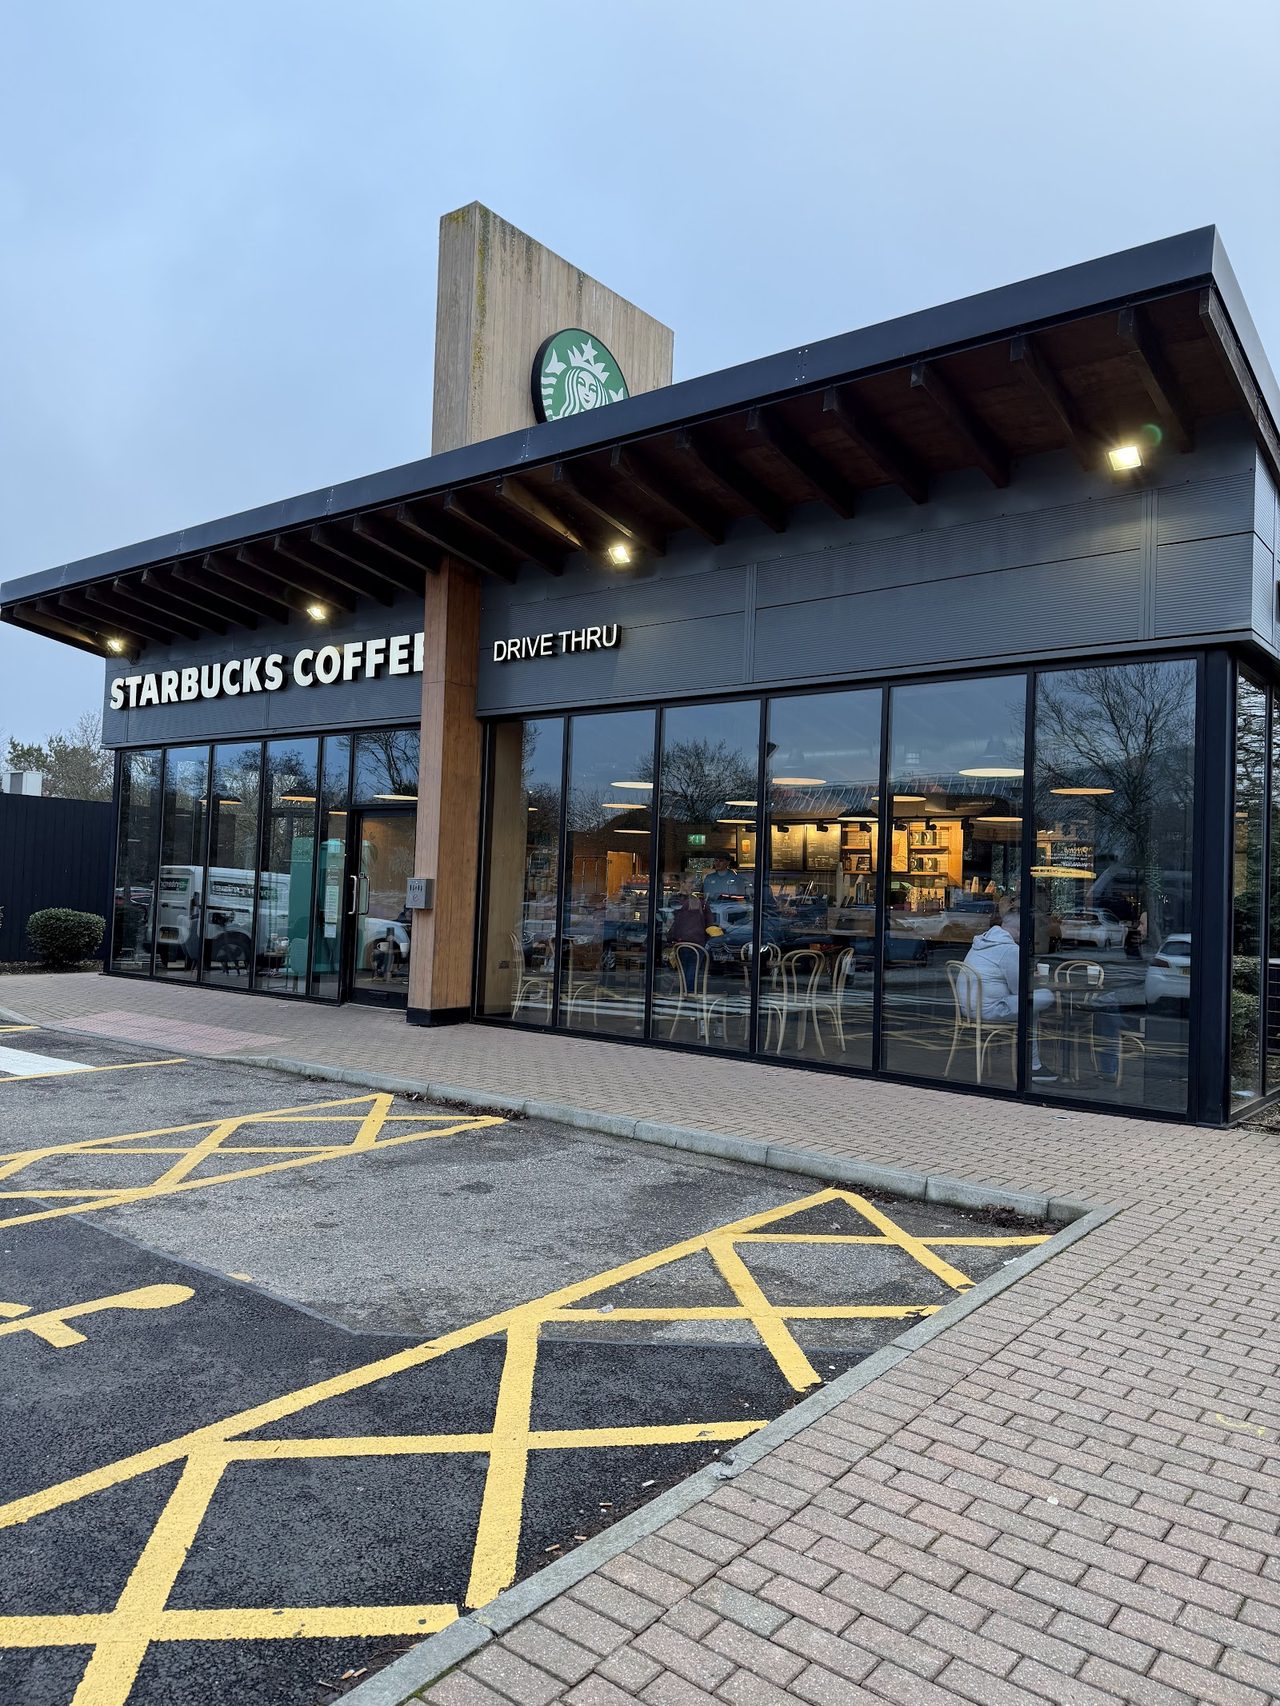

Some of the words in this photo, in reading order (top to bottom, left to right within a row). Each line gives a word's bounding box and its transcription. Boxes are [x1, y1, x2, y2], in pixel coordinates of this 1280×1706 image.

[493, 633, 553, 662] DRIVE
[558, 624, 618, 653] THRU
[110, 653, 283, 710] STARBUCKS
